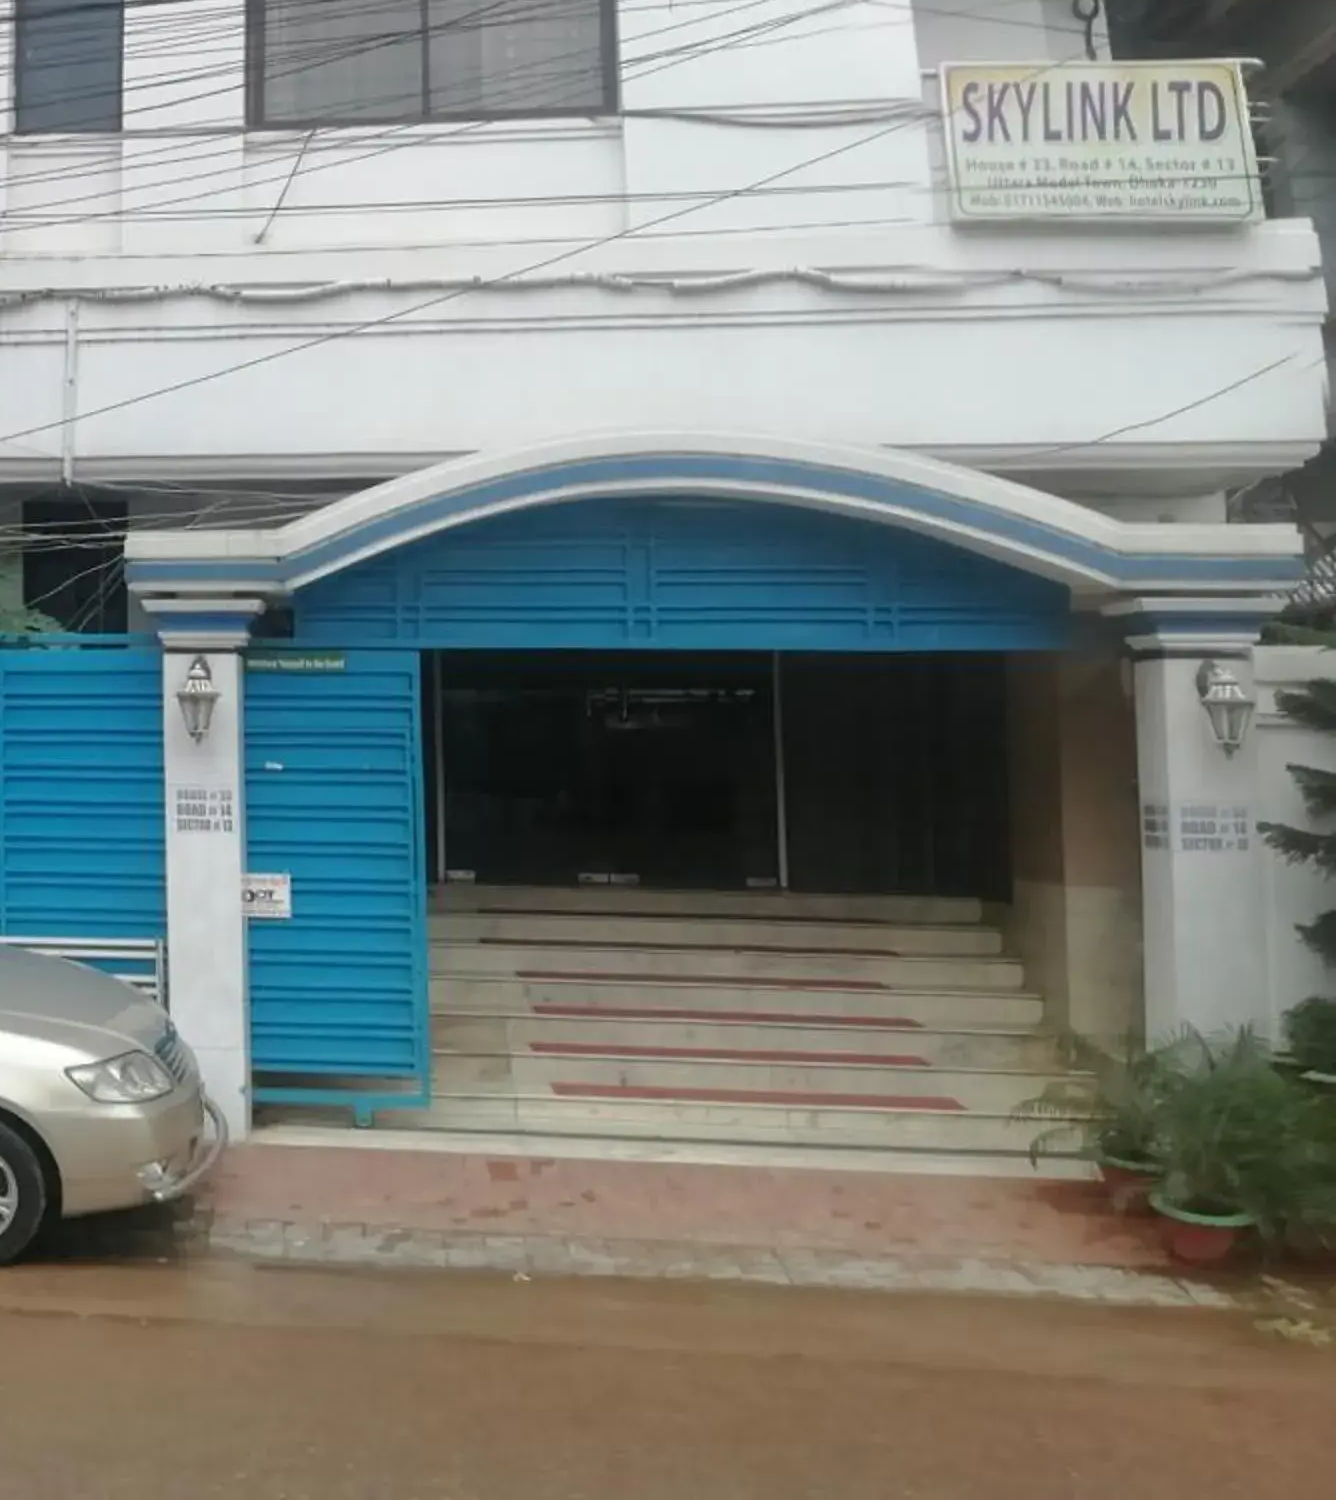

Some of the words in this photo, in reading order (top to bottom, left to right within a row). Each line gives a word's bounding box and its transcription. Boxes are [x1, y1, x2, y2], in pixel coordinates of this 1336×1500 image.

[961, 81, 1138, 143] SKYLINK
[1151, 80, 1227, 142] LTD
[965, 157, 1014, 172] House
[1059, 157, 1099, 171] Road
[1145, 156, 1196, 171] Sector
